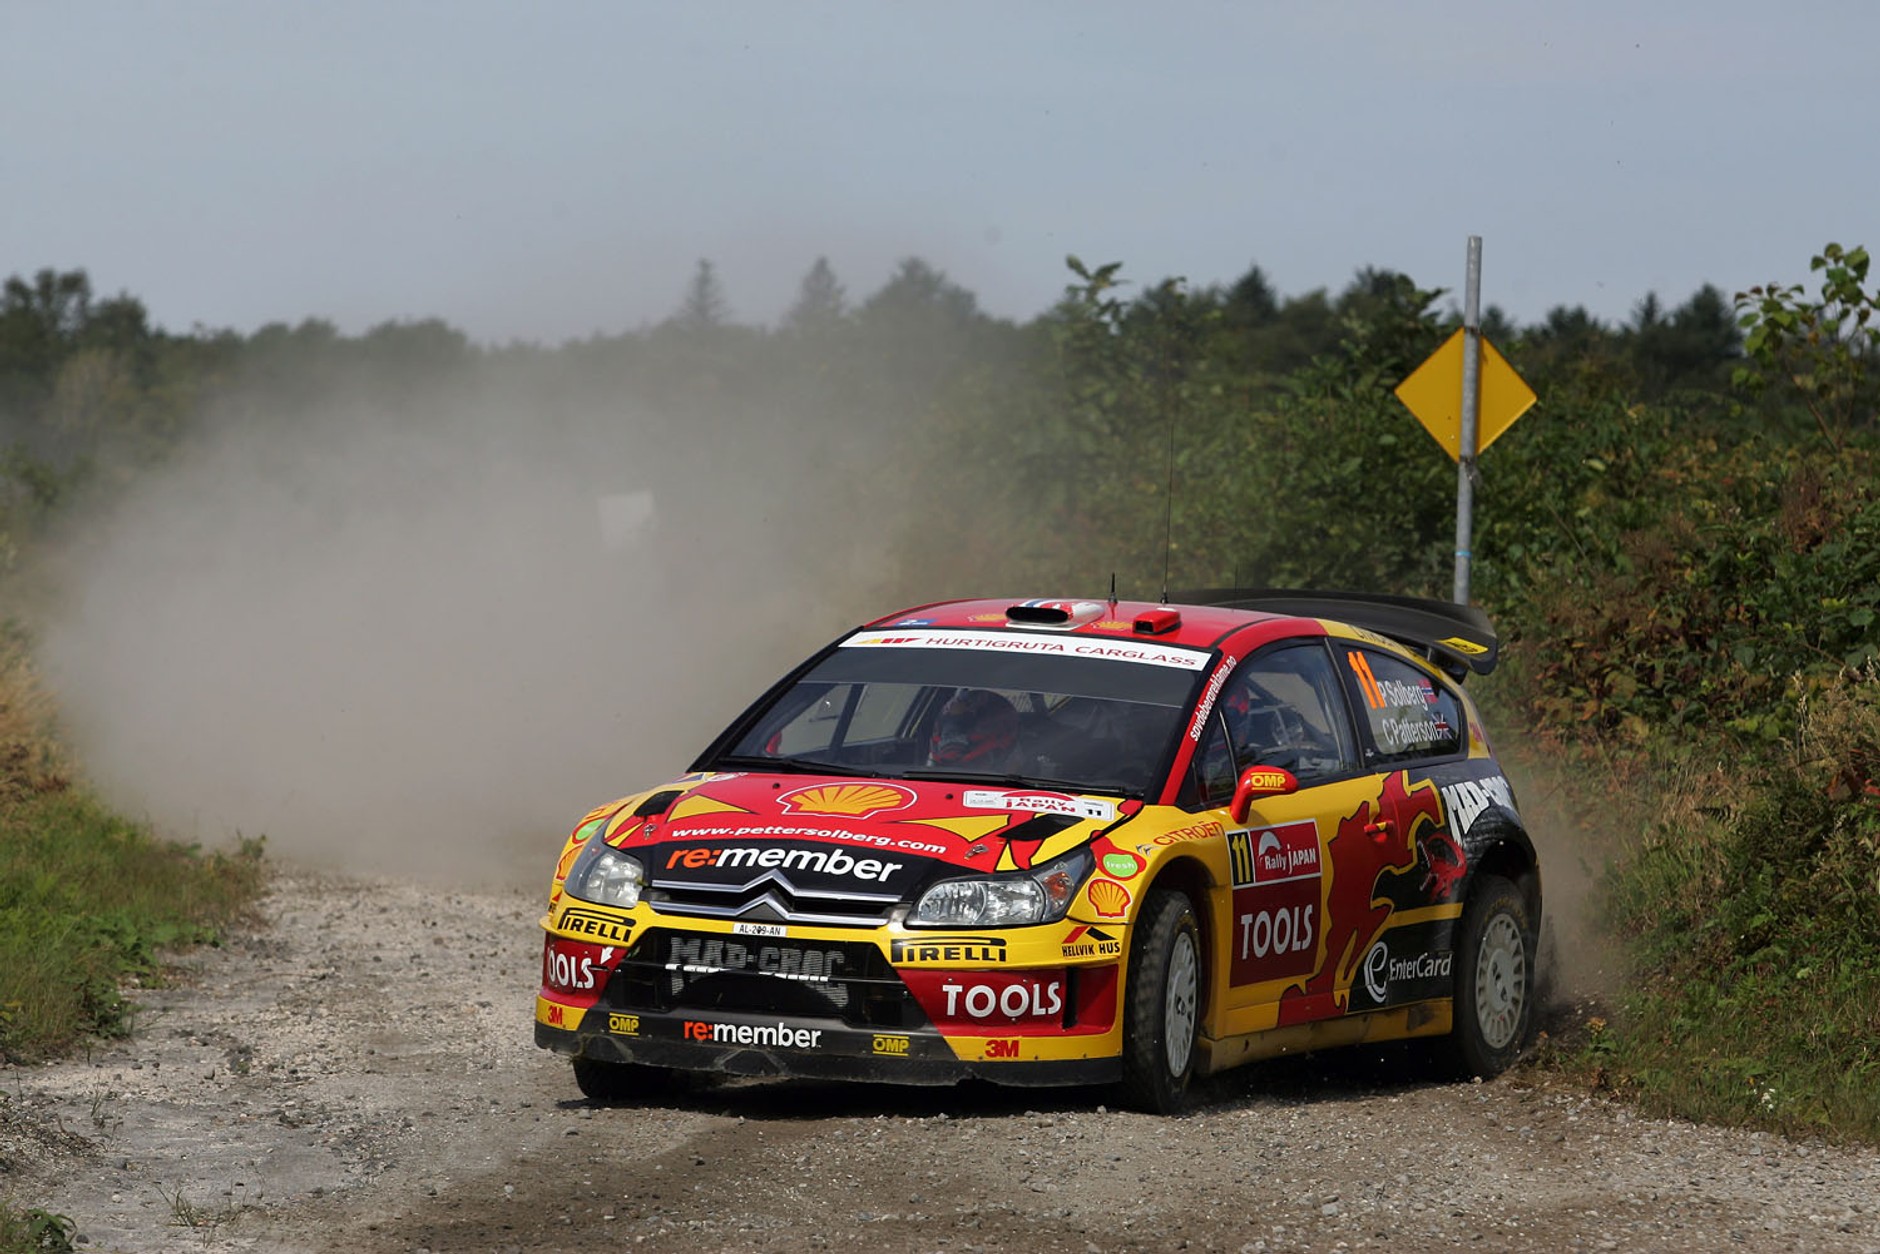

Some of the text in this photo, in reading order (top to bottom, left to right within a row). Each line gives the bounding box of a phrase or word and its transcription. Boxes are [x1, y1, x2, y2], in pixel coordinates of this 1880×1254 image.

[925, 636, 1196, 666] HURTIGRUTA CARGLASS
[1347, 651, 1386, 709] 11
[1385, 680, 1429, 711] Solberg
[1382, 718, 1394, 745] C
[1389, 718, 1443, 744] Patterson
[1251, 774, 1286, 788] OMP
[671, 824, 946, 854] www.pettersolberg.com
[666, 847, 902, 882] re:member
[1106, 861, 1135, 870] fresh
[1231, 834, 1251, 884] 11
[1264, 853, 1287, 871] Rally
[558, 907, 636, 943] PIRELLI
[1241, 904, 1314, 960] TOOLS
[890, 936, 1007, 962] PIRELLI
[1061, 942, 1120, 957] HELLVIK HUS
[1389, 952, 1453, 981] EnterCard
[942, 981, 1062, 1018] TOOLS
[547, 1005, 563, 1025] 3M
[609, 1017, 639, 1032] OMP
[683, 1020, 822, 1048] re:member
[872, 1038, 909, 1052] OMP
[985, 1040, 1020, 1058] 3M
